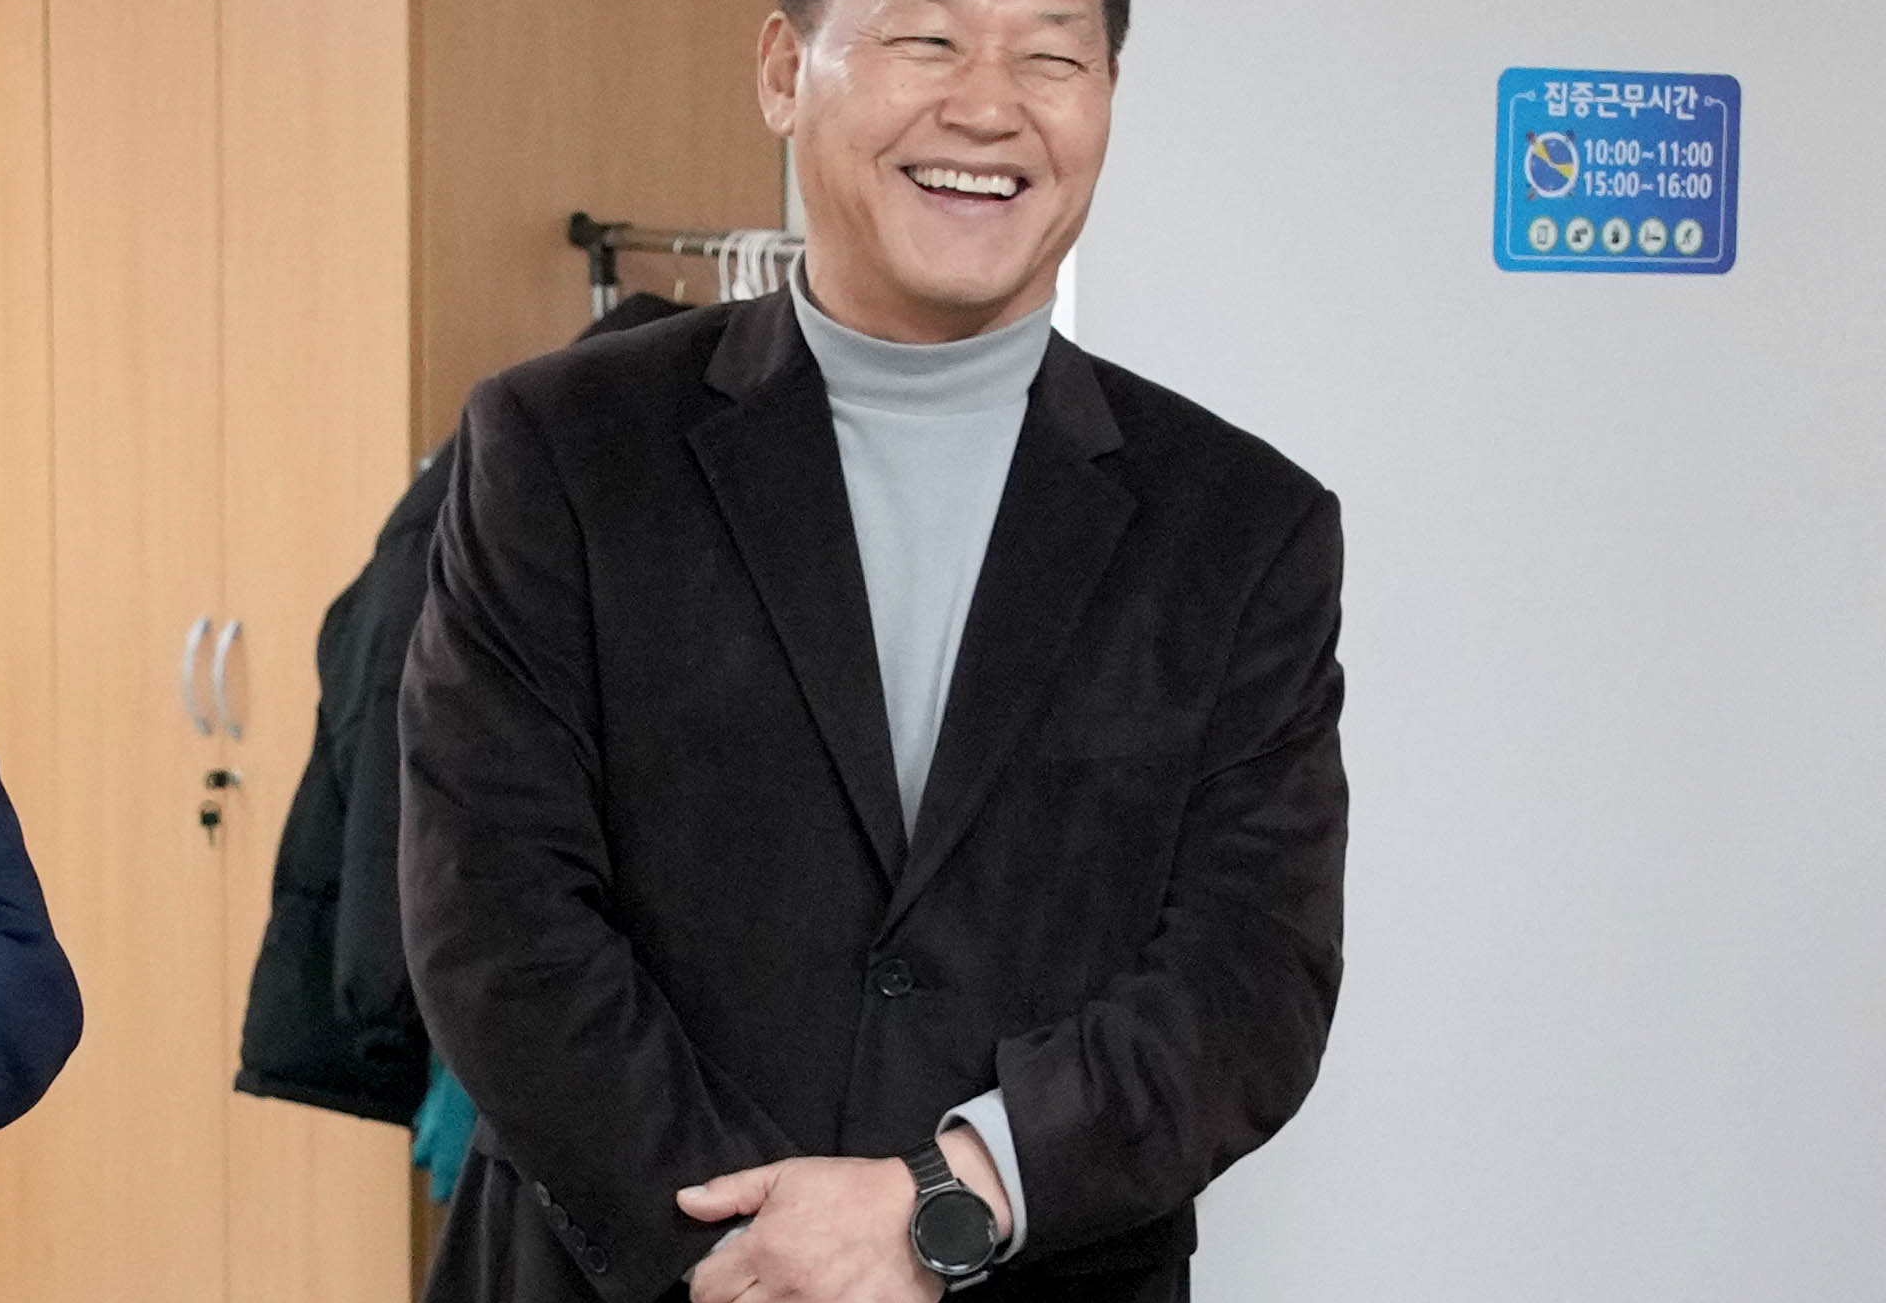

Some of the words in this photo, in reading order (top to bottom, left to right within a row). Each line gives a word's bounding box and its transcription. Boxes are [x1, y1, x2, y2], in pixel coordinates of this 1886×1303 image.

[1543, 81, 1699, 121] 집중근무시간
[1583, 138, 1713, 168] 10:00~11:00
[1583, 170, 1712, 199] 15:00~16:00
